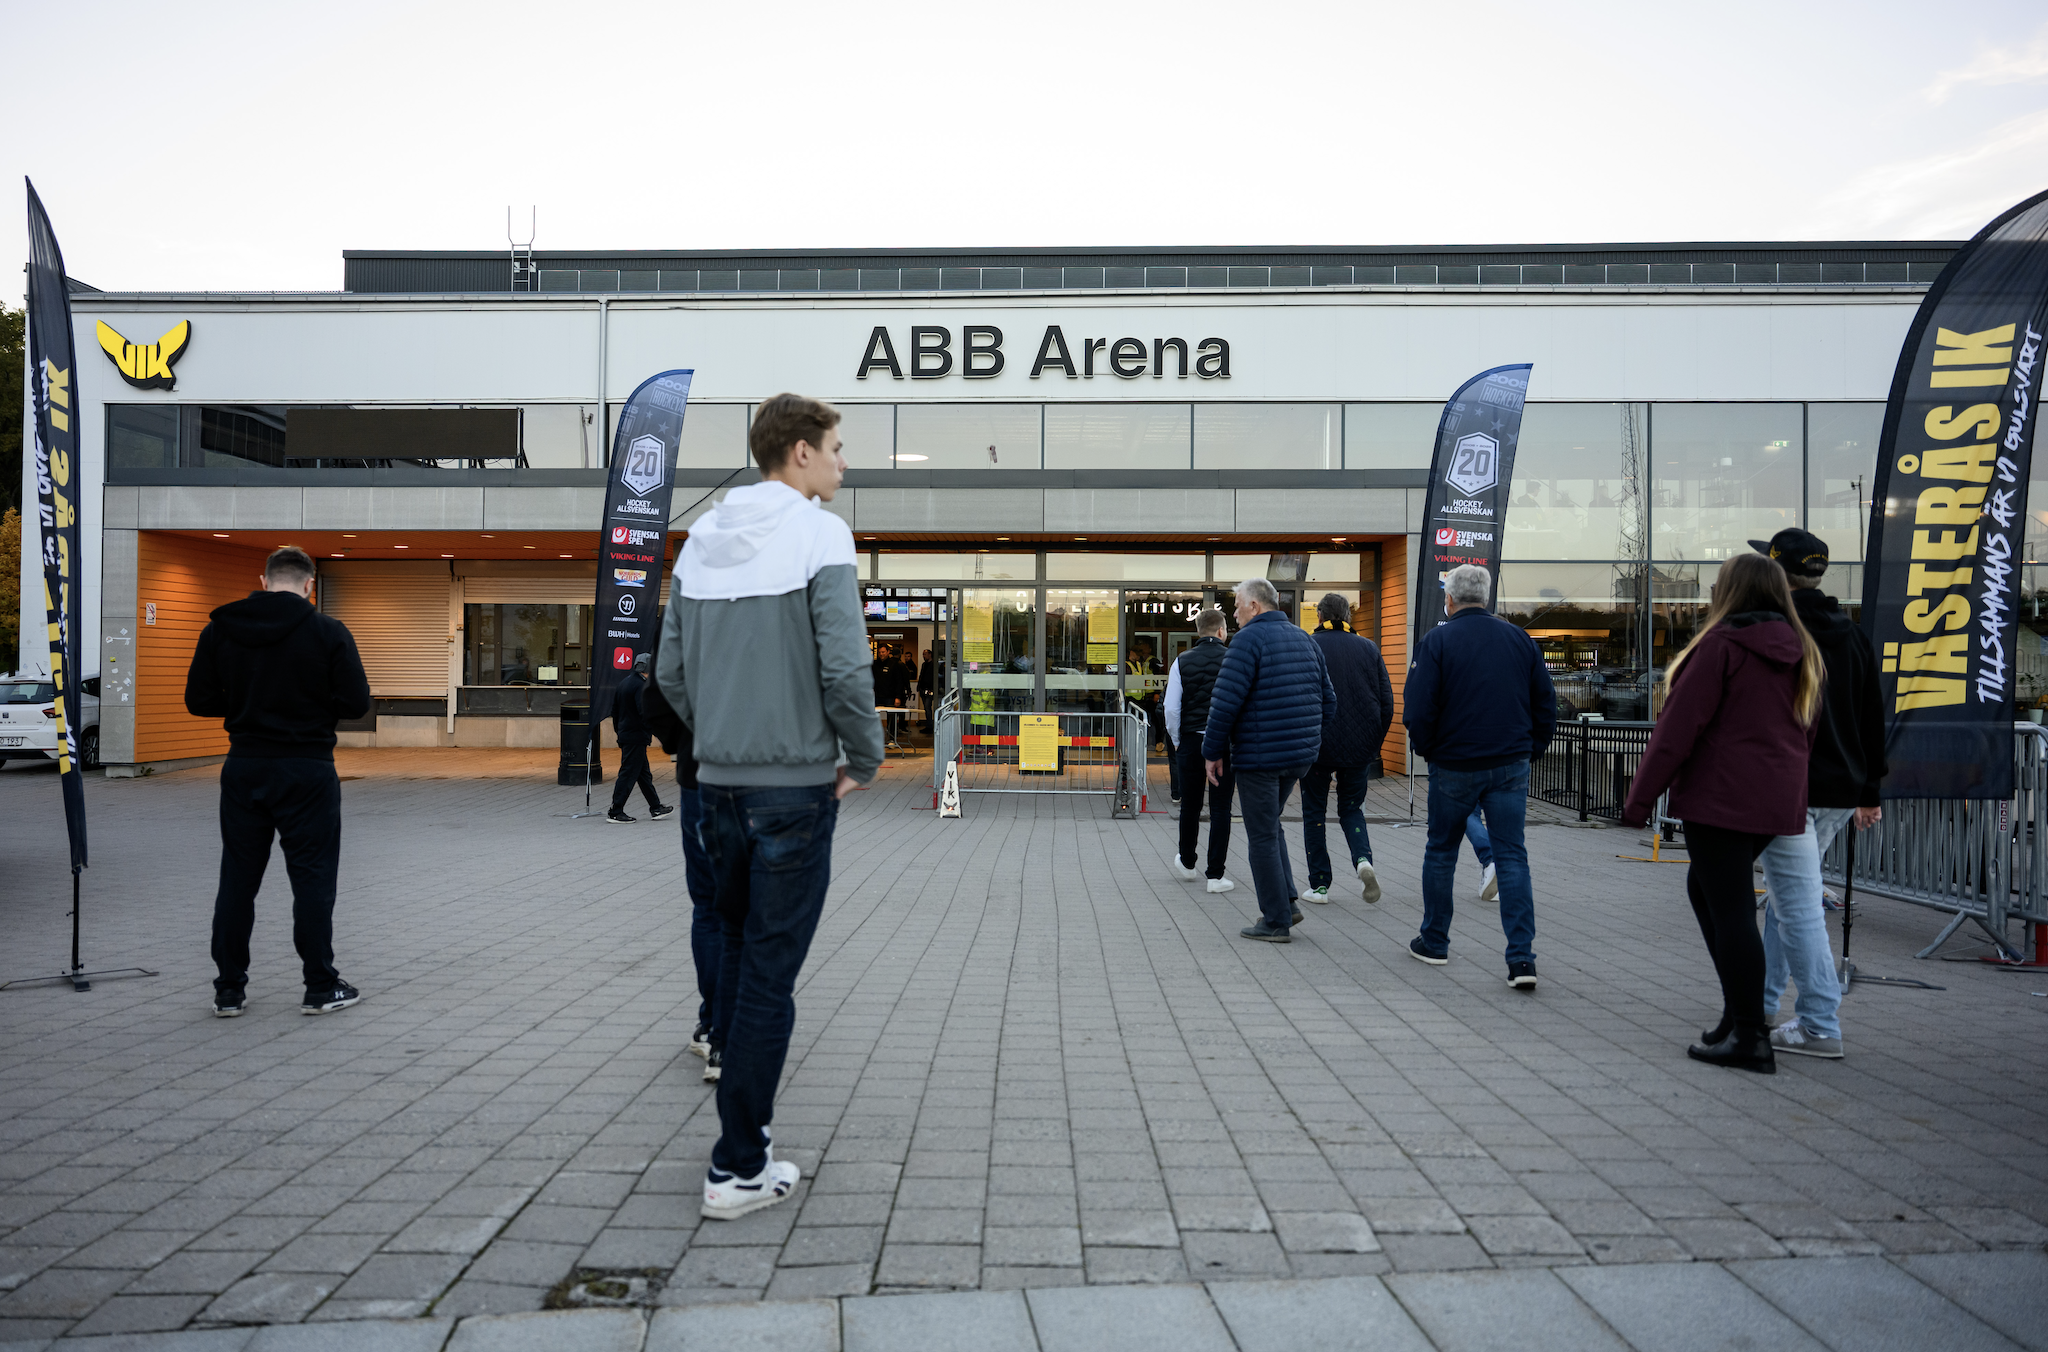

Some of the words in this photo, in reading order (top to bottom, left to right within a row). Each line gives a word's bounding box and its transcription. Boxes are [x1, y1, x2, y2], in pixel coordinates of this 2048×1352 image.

[856, 325, 1006, 379] ABB
[1029, 325, 1232, 379] Arena
[1930, 322, 2016, 388] IK
[1487, 373, 1527, 390] 2005
[630, 449, 658, 477] 20
[1457, 448, 1491, 476] 20
[1996, 456, 2019, 483] VI
[626, 499, 652, 508] HOCKEY
[1453, 499, 1483, 508] HOCKEY
[1983, 487, 2018, 529] ÄR
[616, 505, 660, 515] ALLSVENSKAN
[1440, 505, 1494, 516] ALLSVENSKAN
[629, 529, 660, 540] SVENSKA
[1456, 530, 1494, 541] SVENSKA
[628, 537, 644, 545] SPEL
[1455, 538, 1475, 547] SPEL
[610, 552, 636, 561] VIKING
[637, 554, 656, 563] LINE
[1434, 554, 1466, 564] VIKING
[1468, 557, 1489, 566] LINE
[1882, 402, 2002, 714] VÄSTERÅS
[1975, 531, 2014, 704] TILLSAMMANS
[7, 737, 19, 745] 193
[947, 771, 955, 799] VIK
